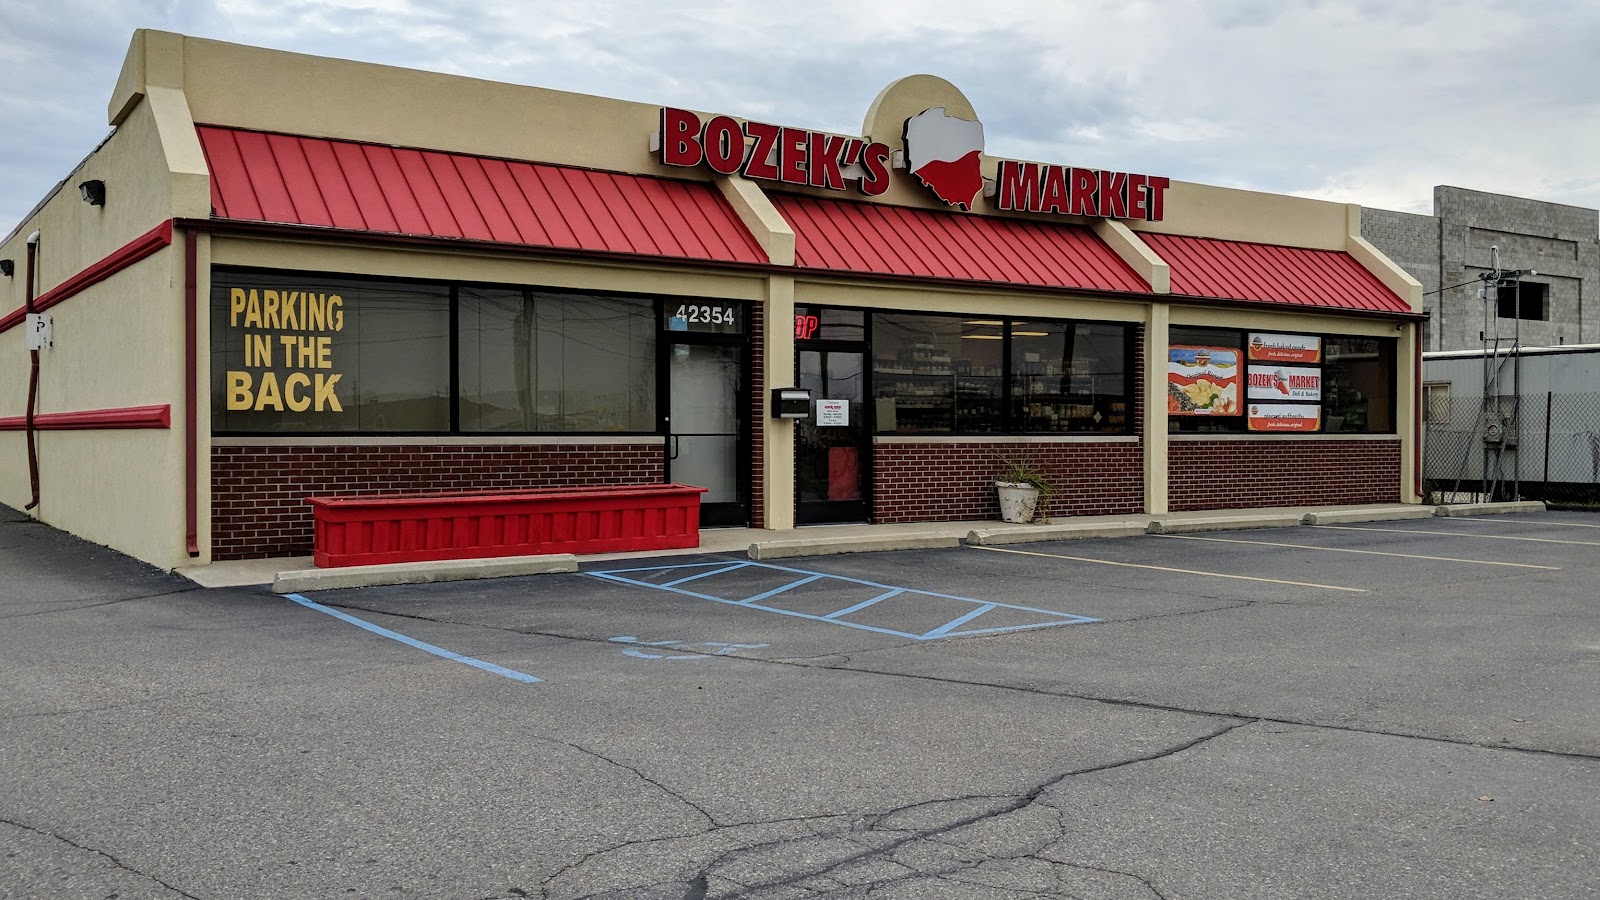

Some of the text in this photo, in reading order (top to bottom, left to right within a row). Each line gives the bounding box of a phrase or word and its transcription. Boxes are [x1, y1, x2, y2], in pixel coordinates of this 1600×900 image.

[660, 106, 1170, 222] BOZEK'S MARKET
[230, 287, 344, 332] PARKING
[676, 305, 735, 326] 42354
[244, 334, 332, 369] IN THE
[226, 371, 343, 412] BACK
[1248, 373, 1319, 389] BOZEK'S MARKET
